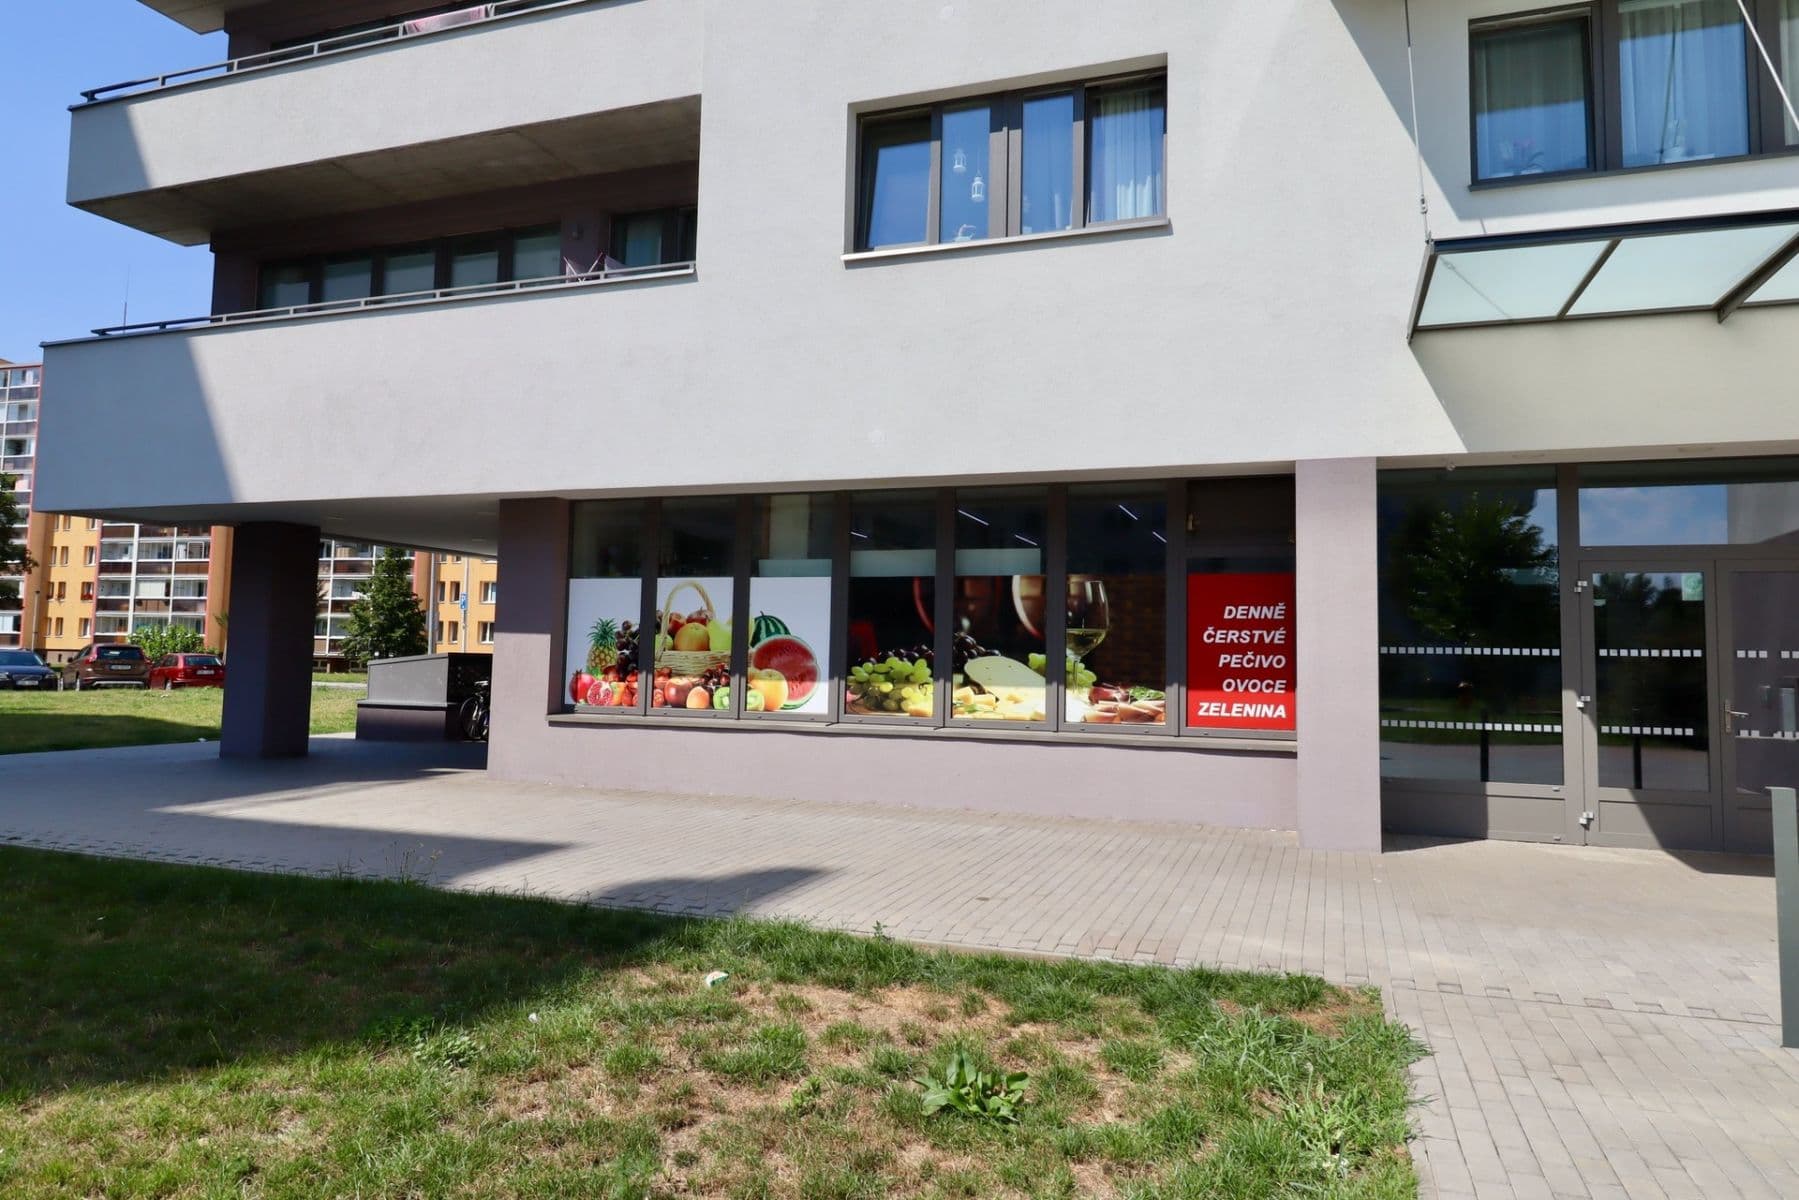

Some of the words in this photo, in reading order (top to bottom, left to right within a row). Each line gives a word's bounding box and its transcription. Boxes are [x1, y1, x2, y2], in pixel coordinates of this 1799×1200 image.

[1223, 603, 1286, 619] DENNĚ
[1203, 627, 1286, 644] ČERSTVÉ
[1218, 651, 1286, 669] PEČIVO
[1222, 679, 1287, 693] OVOCE
[1198, 702, 1286, 718] ZELENINA
